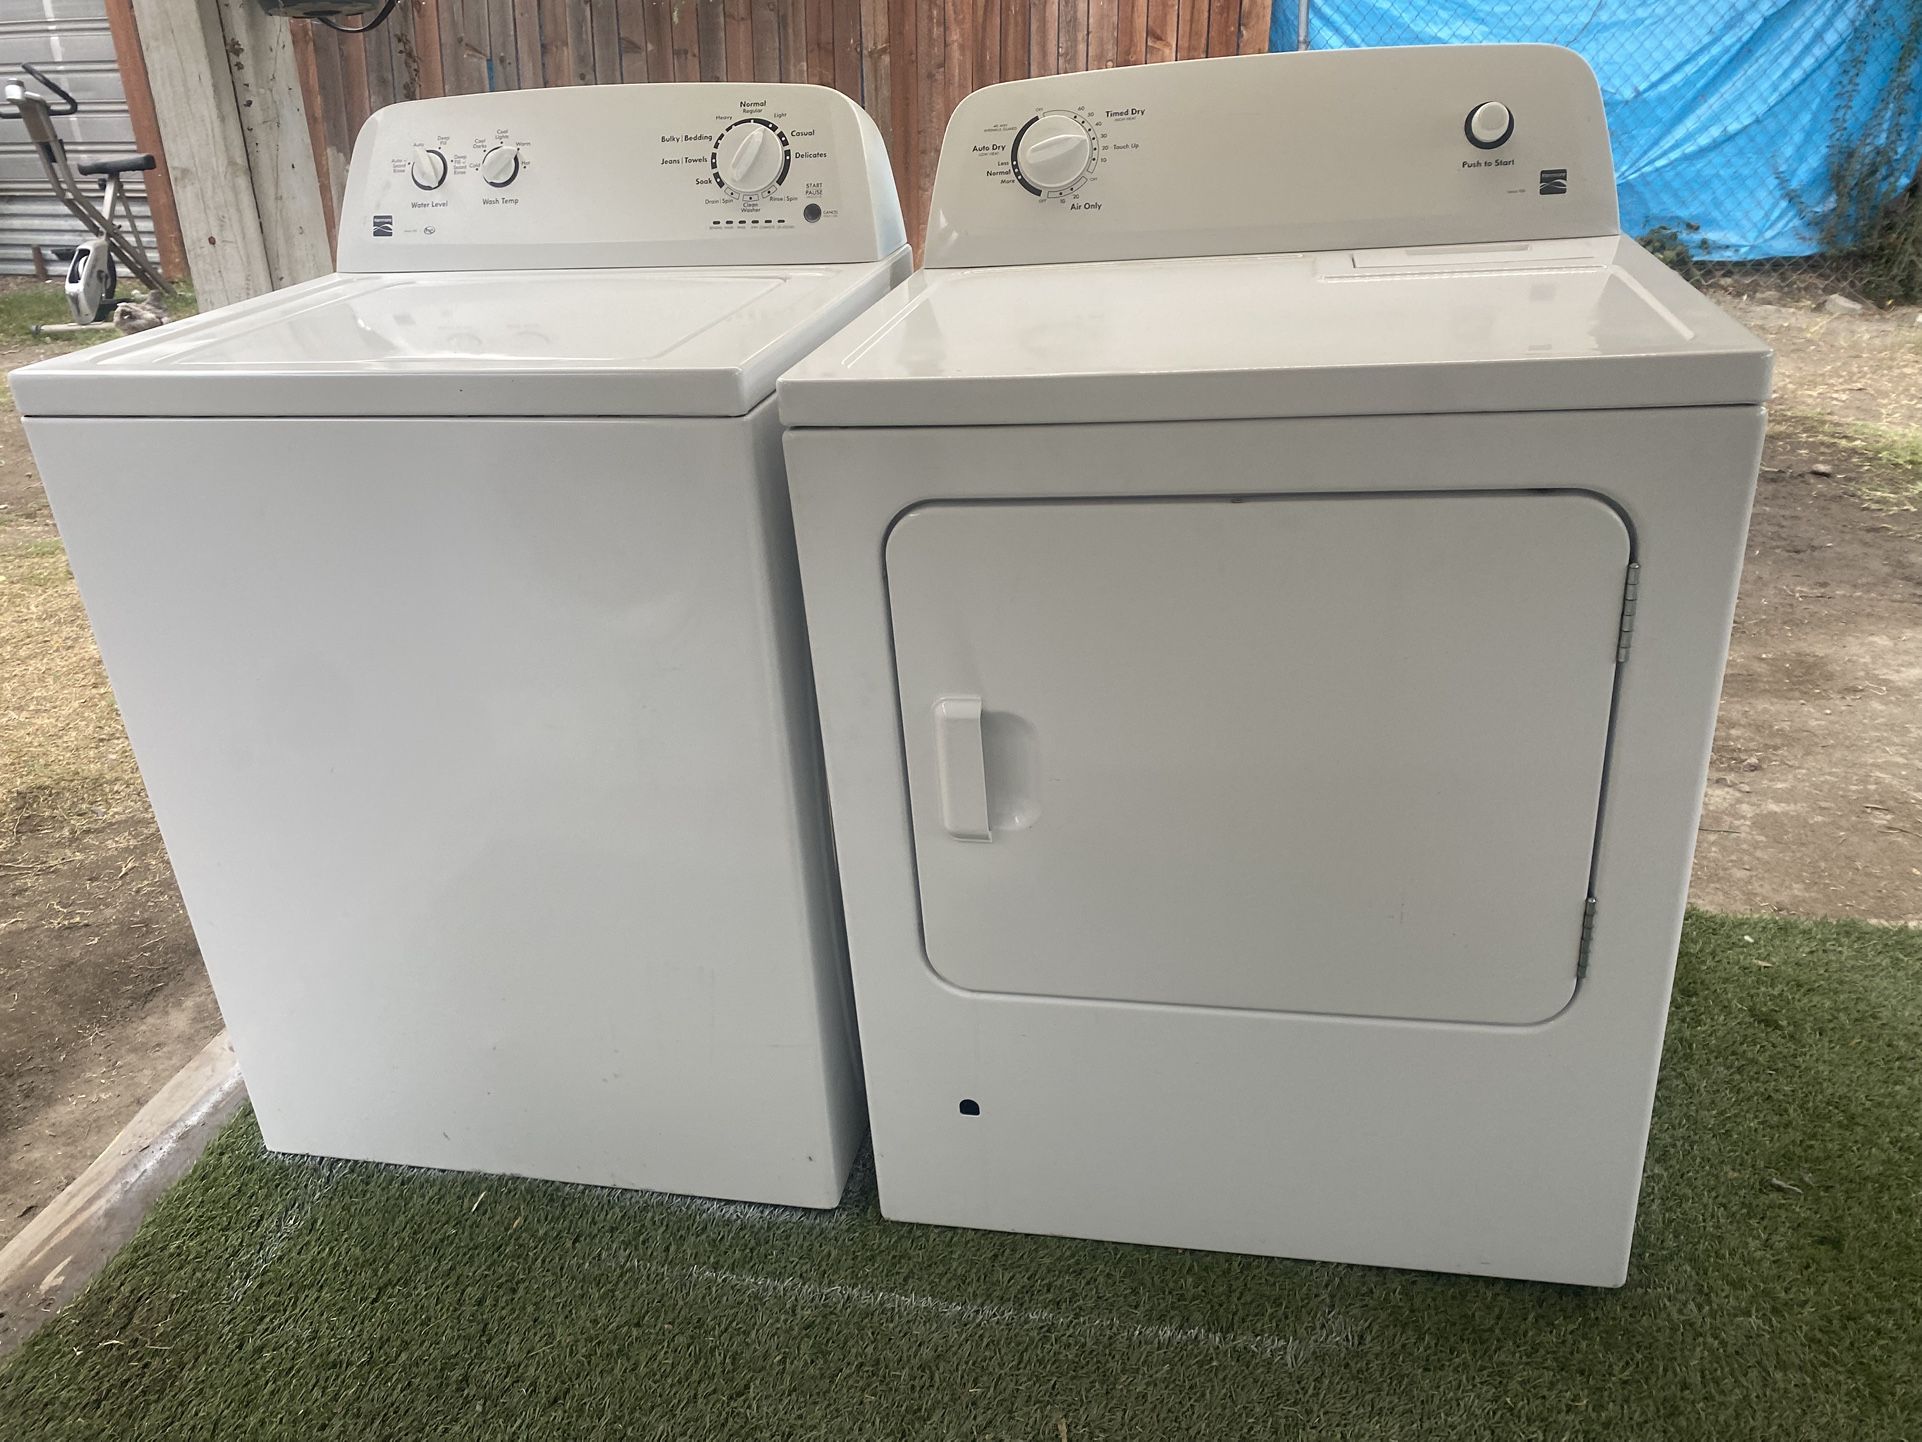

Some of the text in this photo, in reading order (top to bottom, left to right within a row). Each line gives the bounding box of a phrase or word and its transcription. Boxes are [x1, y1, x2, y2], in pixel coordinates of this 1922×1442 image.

[740, 100, 766, 108] Normal
[1131, 108, 1145, 116] Dry
[684, 134, 712, 142] Bedding
[795, 151, 827, 159] Delicates
[1462, 160, 1482, 168] Push
